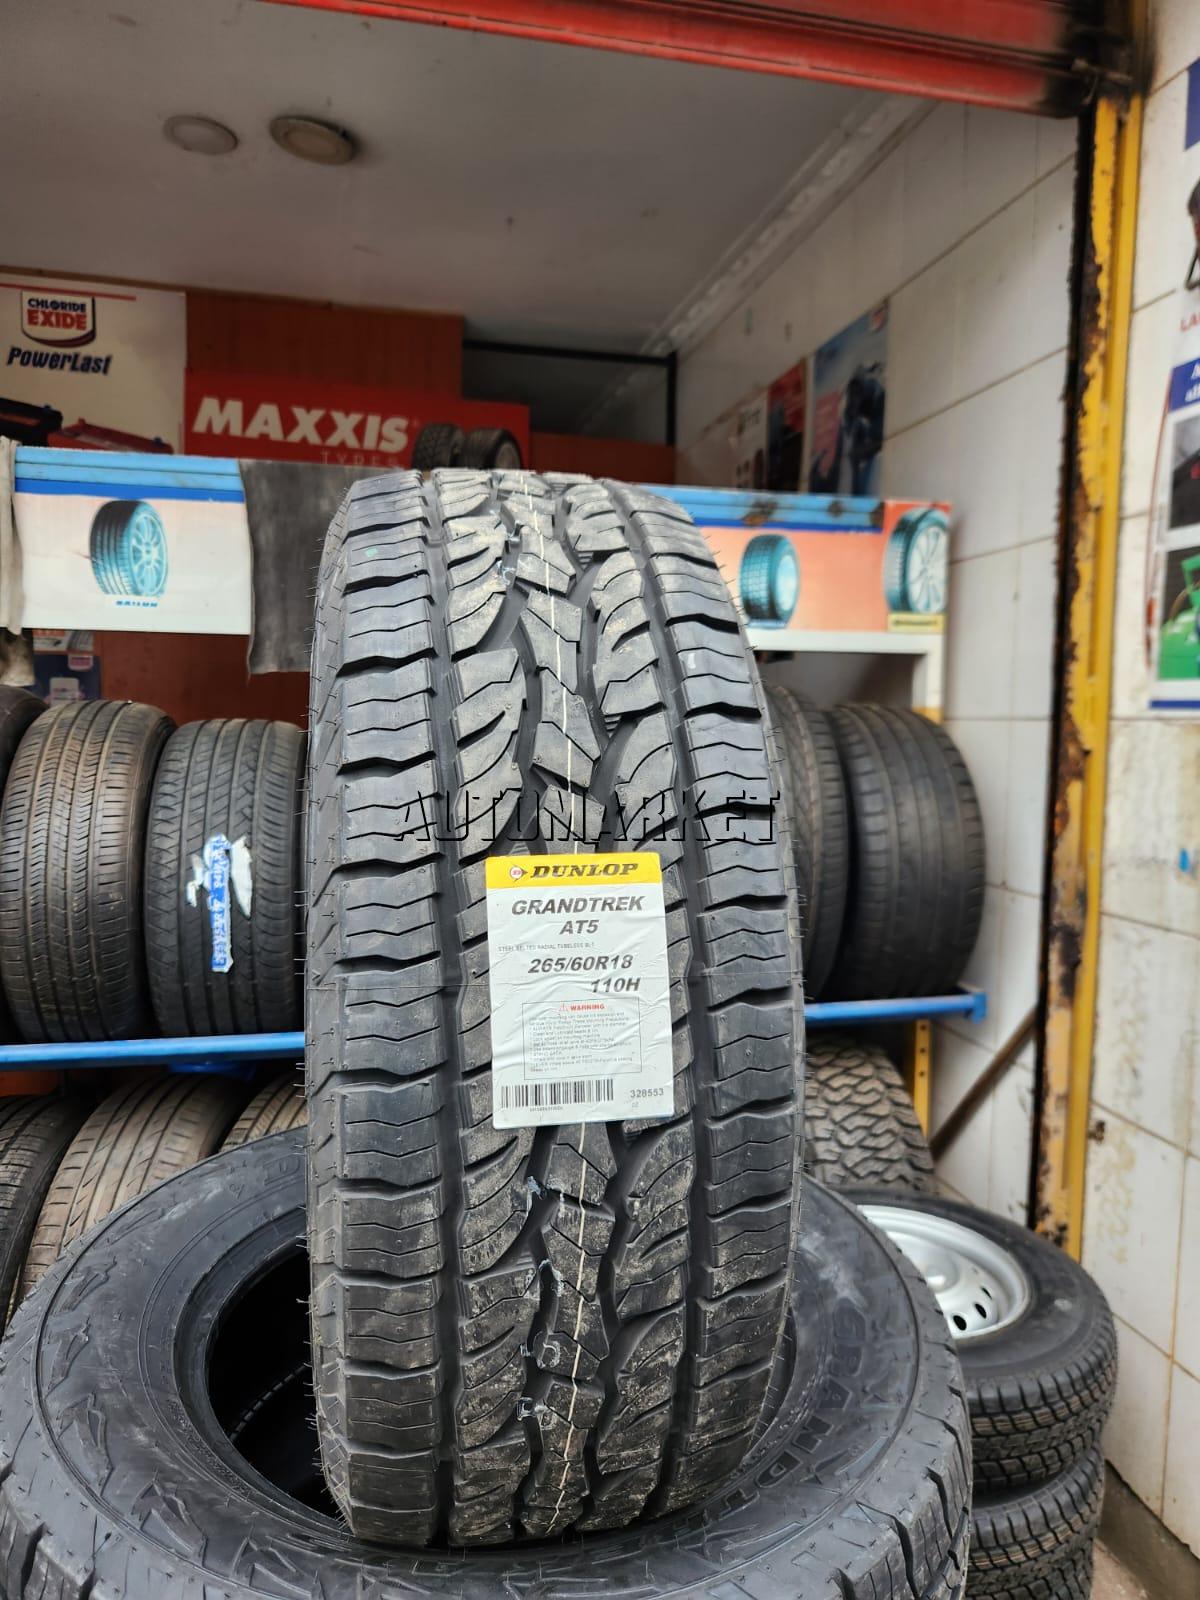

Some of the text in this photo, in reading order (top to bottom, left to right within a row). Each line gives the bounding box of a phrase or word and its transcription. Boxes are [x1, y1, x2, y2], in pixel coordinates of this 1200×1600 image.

[27, 297, 87, 312] CHLORIDE
[26, 309, 88, 331] EXIDE
[6, 346, 113, 376] PowerLast
[191, 396, 410, 454] MAXXIS
[530, 863, 639, 879] DUNLOP
[511, 895, 646, 916] GRANDTREK
[559, 919, 600, 935] AT5
[528, 954, 634, 974] 265/60R18
[590, 977, 642, 994] 110H
[570, 1003, 605, 1012] WARNING
[629, 1087, 665, 1099] 328553
